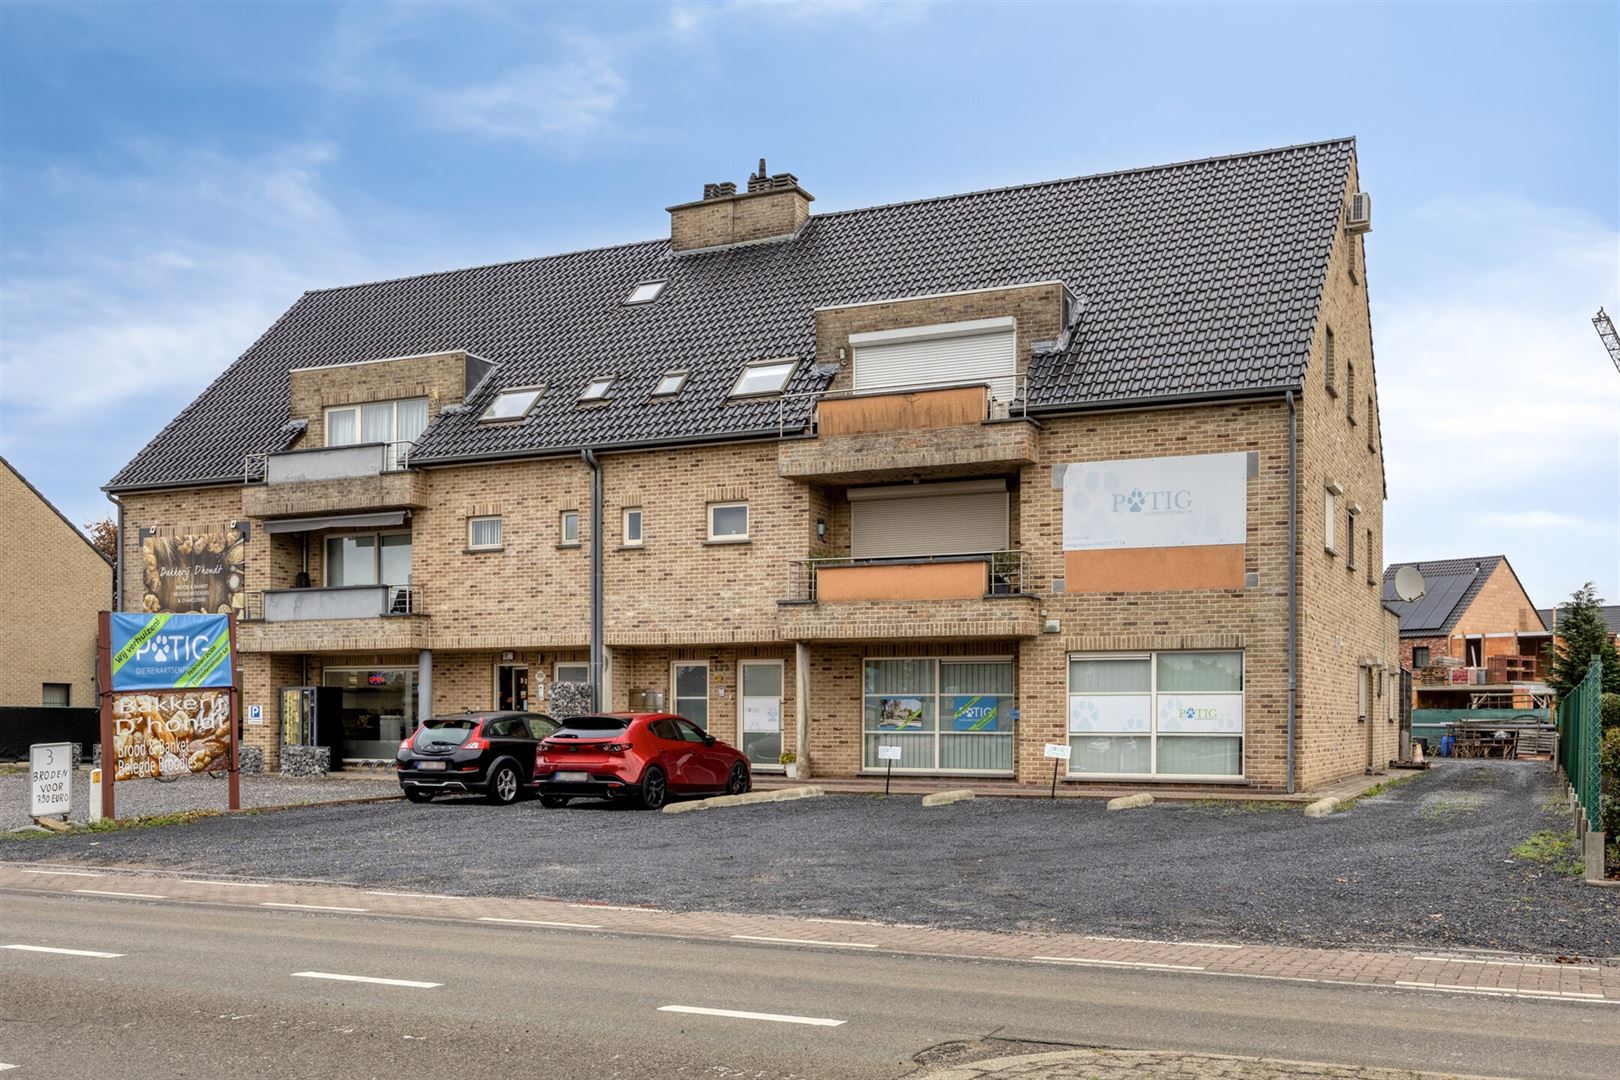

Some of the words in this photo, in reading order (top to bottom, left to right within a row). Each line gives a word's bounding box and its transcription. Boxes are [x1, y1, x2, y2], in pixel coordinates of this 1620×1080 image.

[1112, 488, 1193, 513] PTIG
[115, 650, 127, 664] Wij
[127, 618, 161, 653] verhuizen!
[136, 635, 209, 662] PTIG
[136, 666, 190, 676] DIERENARTSENP
[121, 696, 225, 713] Bakkerij
[1179, 706, 1217, 719] PTIG
[46, 748, 53, 765] 3
[118, 740, 147, 758] Brood
[160, 738, 190, 757] Banket
[118, 756, 159, 778] Belegde
[159, 754, 198, 775] Broodjes
[33, 769, 68, 782] BRODEN
[40, 782, 64, 793] VOOR
[51, 793, 69, 803] EURO
